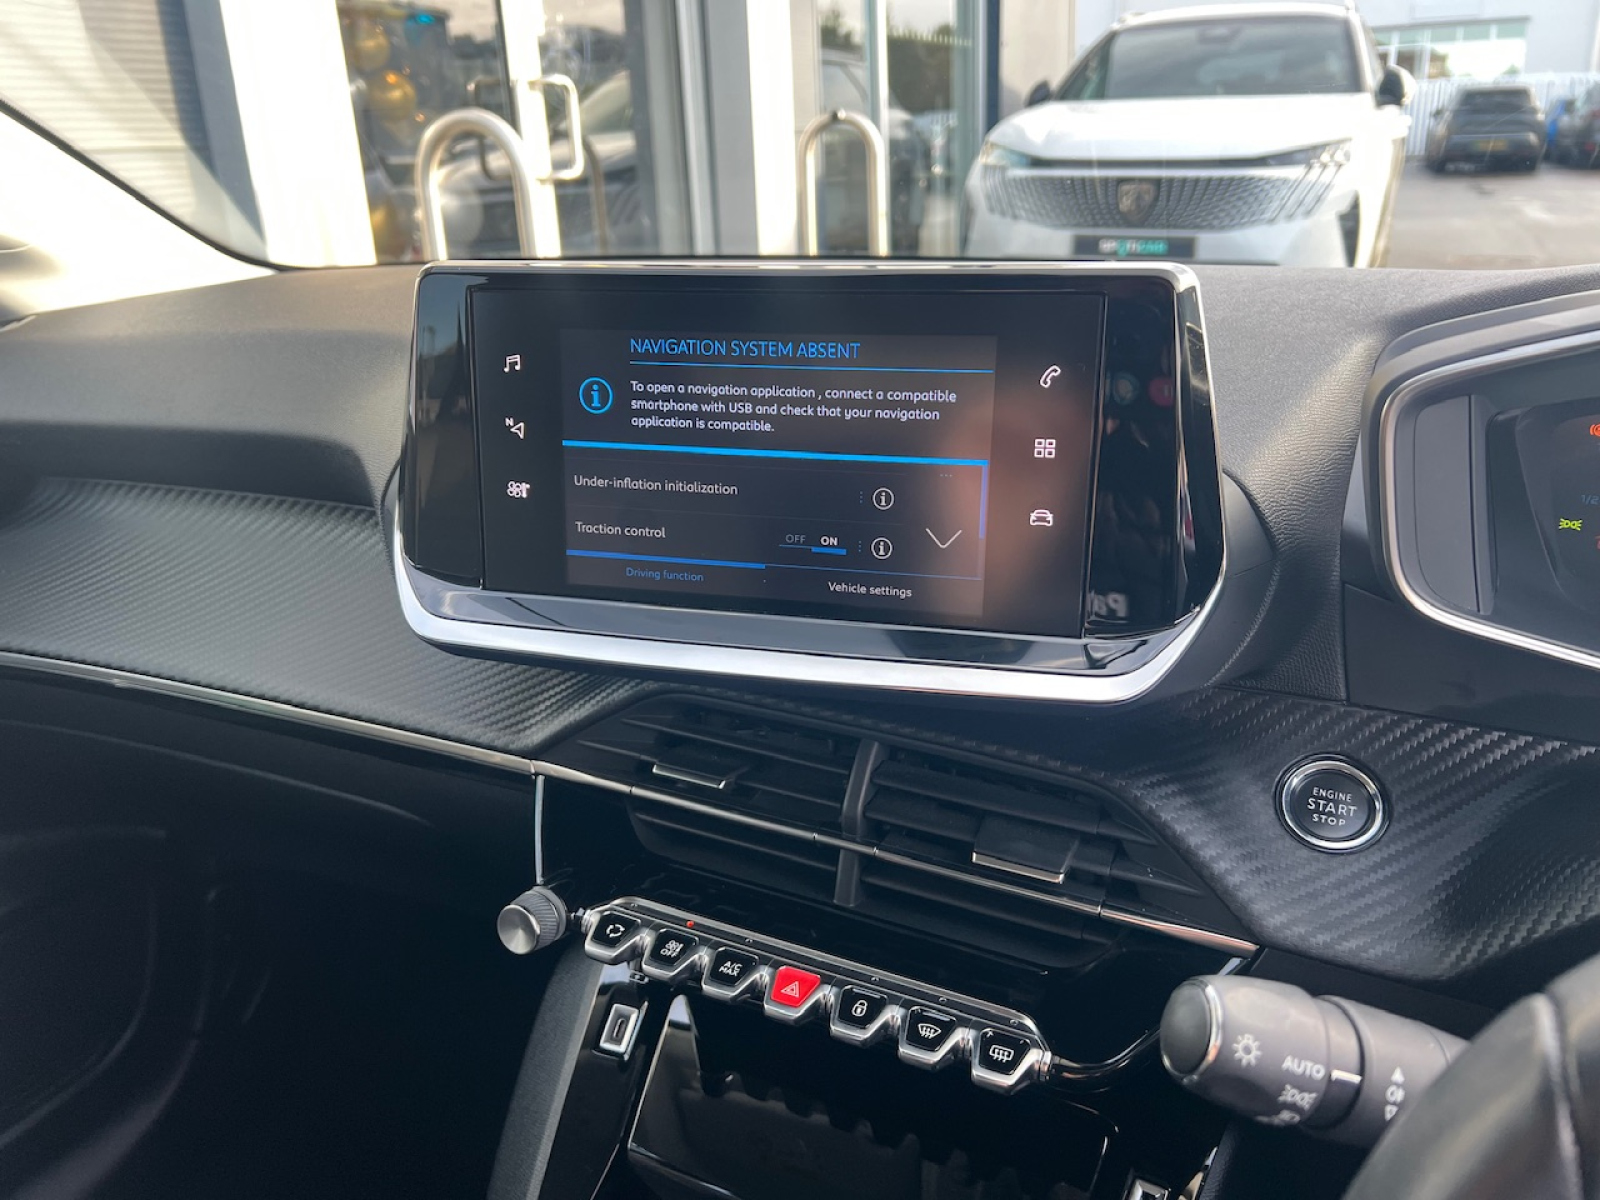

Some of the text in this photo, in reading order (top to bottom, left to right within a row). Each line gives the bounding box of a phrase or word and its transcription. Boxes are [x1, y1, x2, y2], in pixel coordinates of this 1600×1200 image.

[630, 338, 861, 359] NAVIGATION SYSTEM ABSENT
[630, 380, 644, 392] To
[646, 383, 675, 395] open
[677, 384, 685, 393] a
[687, 384, 747, 397] navigation
[825, 389, 873, 400] connect
[875, 390, 884, 400] a
[886, 390, 957, 404] compatible
[631, 399, 940, 421] smartphone with USB and check that your navigation
[631, 415, 775, 432] application is compatible.
[574, 474, 739, 495] Under-inflation initialization
[575, 521, 666, 538] Traction control
[785, 534, 838, 546] OFF ON
[625, 566, 704, 582] Driving function
[828, 581, 912, 599] Vehicle settings
[1313, 787, 1352, 802] ENGINE
[1307, 798, 1357, 817] START
[1312, 814, 1345, 826] STOP
[660, 947, 679, 958] OFF
[718, 966, 741, 977] MAX
[723, 960, 742, 972] A/C
[1281, 1055, 1326, 1080] AUTO
